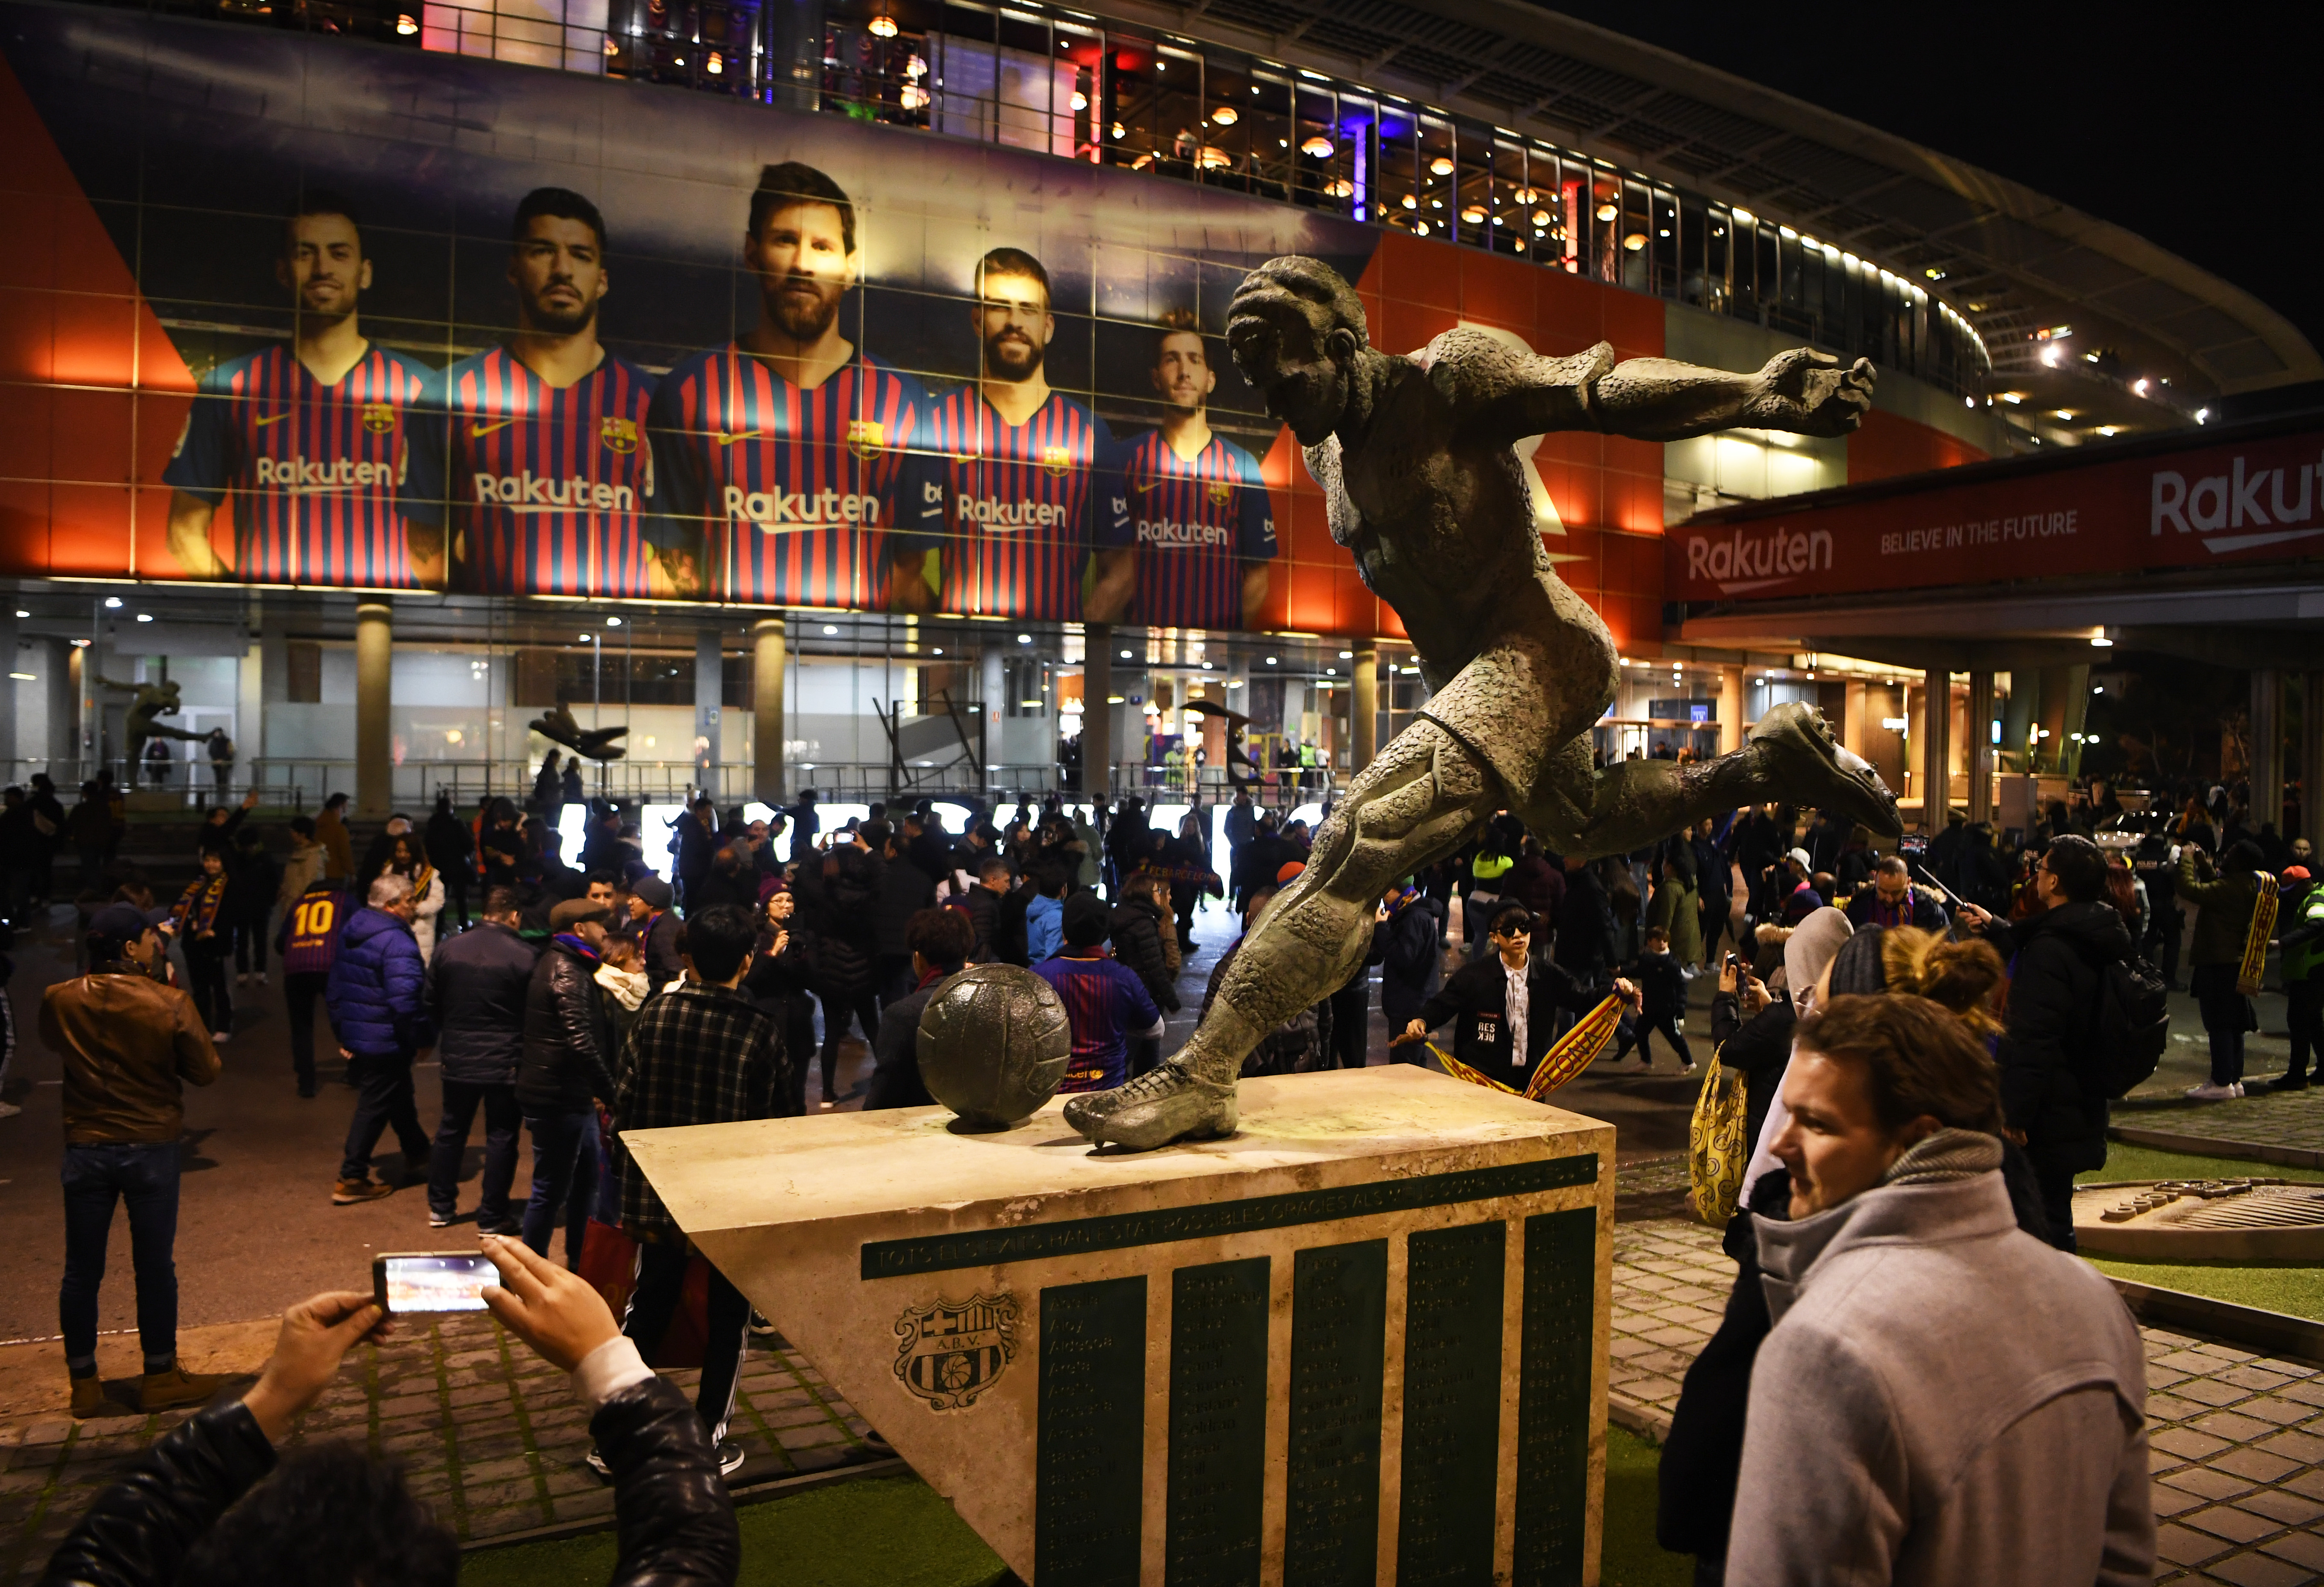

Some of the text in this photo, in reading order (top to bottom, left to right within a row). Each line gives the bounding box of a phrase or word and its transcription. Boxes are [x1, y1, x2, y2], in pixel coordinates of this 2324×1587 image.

[257, 456, 391, 486] Rakuten
[475, 470, 633, 510] Rakuten
[725, 486, 879, 524] Rakuten
[959, 494, 1066, 528] Rakuten
[1138, 517, 1227, 545] Rakuten
[1881, 510, 2077, 555] BELIEVE IN THE FUTURE
[1688, 527, 1833, 581] Rakuten
[295, 900, 335, 936] 10
[1478, 1022, 1496, 1033] RES
[879, 1245, 932, 1268] TOTS
[940, 1241, 979, 1261] ELS
[1050, 1227, 1090, 1248] HAN
[1098, 1219, 1156, 1242] ESTAT
[1353, 1189, 1383, 1209] ALS
